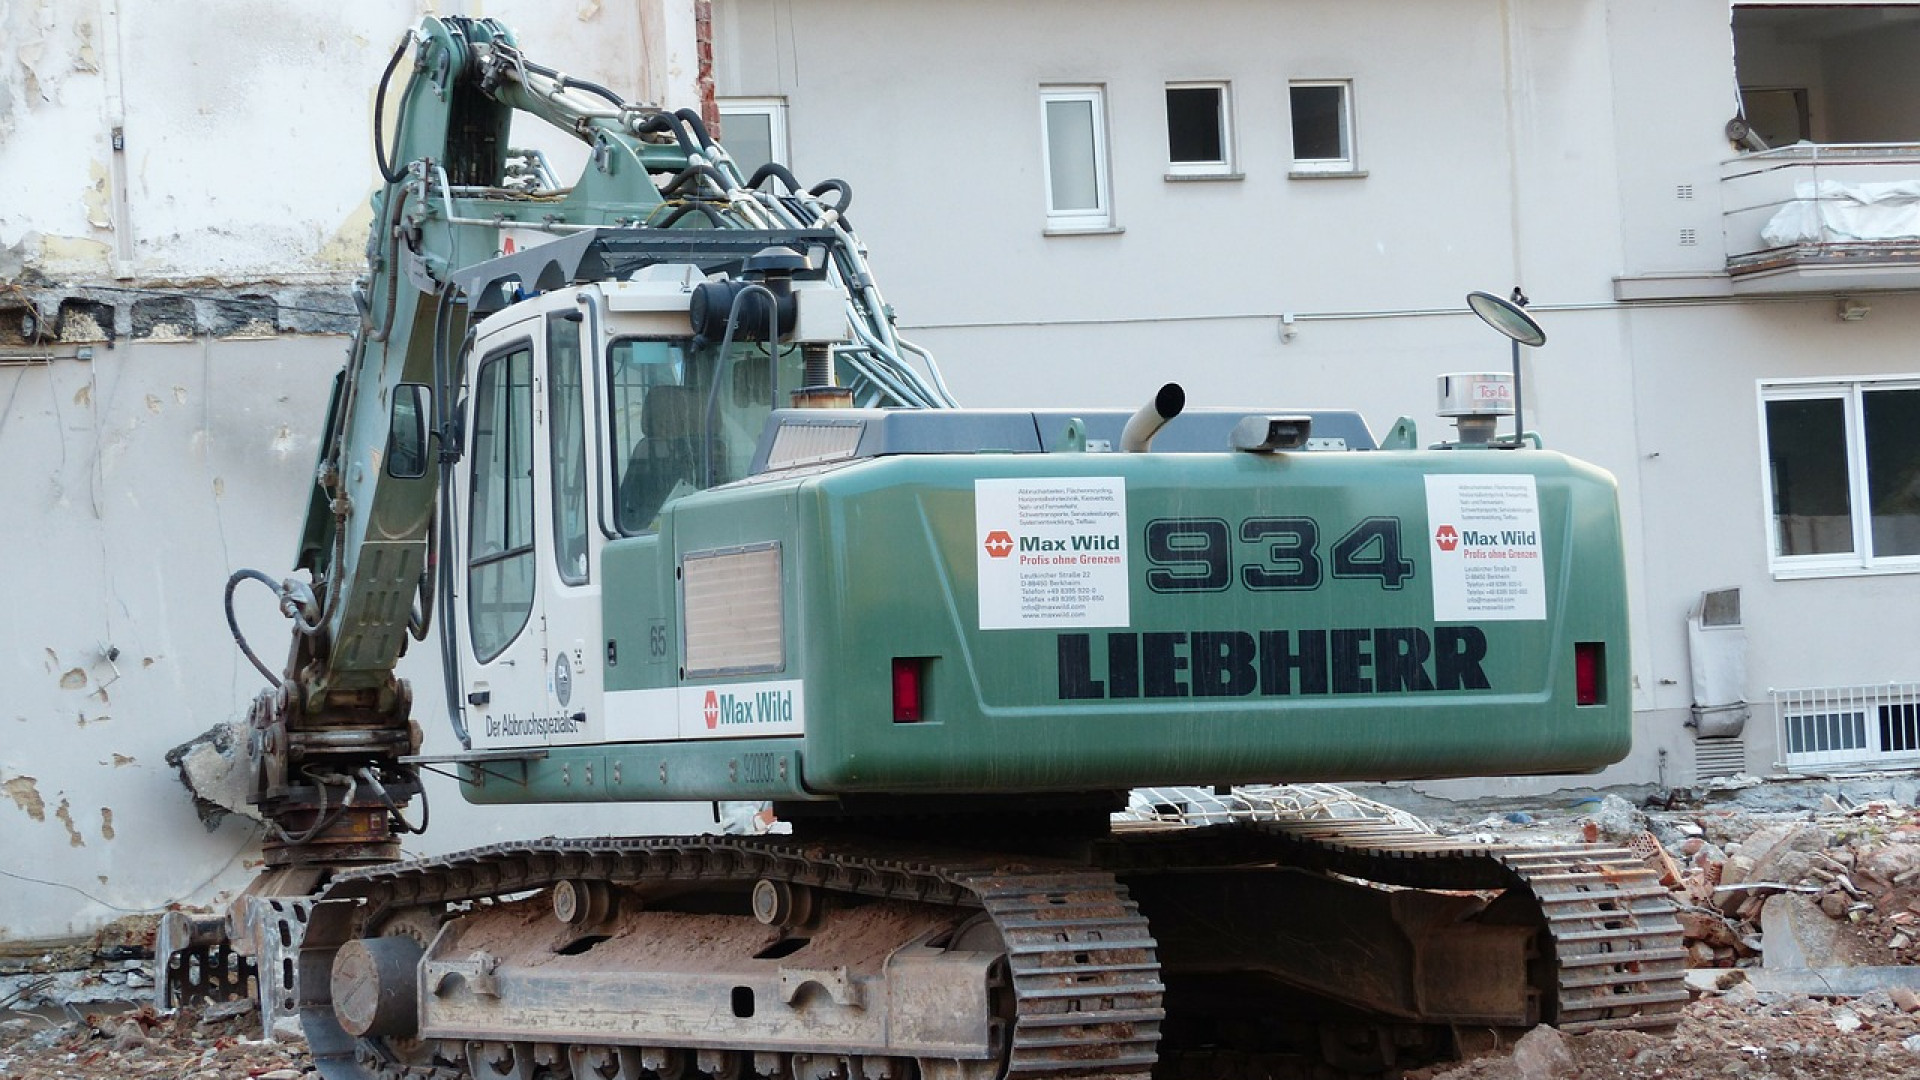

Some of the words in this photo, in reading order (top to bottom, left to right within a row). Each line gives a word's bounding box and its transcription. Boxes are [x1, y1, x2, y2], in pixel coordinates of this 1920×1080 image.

[1020, 536, 1067, 552] Max
[1071, 535, 1120, 551] Wild
[1462, 530, 1498, 546] Max
[1500, 530, 1537, 546] Wild
[1020, 555, 1050, 565] Profis
[1053, 554, 1078, 565] ohne
[1080, 554, 1121, 565] Grenzen
[1144, 516, 1415, 594] 934
[1463, 548, 1487, 559] Profis
[1488, 549, 1507, 559] ohne
[1508, 548, 1538, 559] Grenzen
[650, 625, 667, 658] 65
[1057, 626, 1492, 700] LIEBHERR
[720, 693, 754, 724] Max
[755, 690, 793, 723] Wild
[485, 714, 501, 738] Der
[502, 710, 579, 740] Abbruchspezialist
